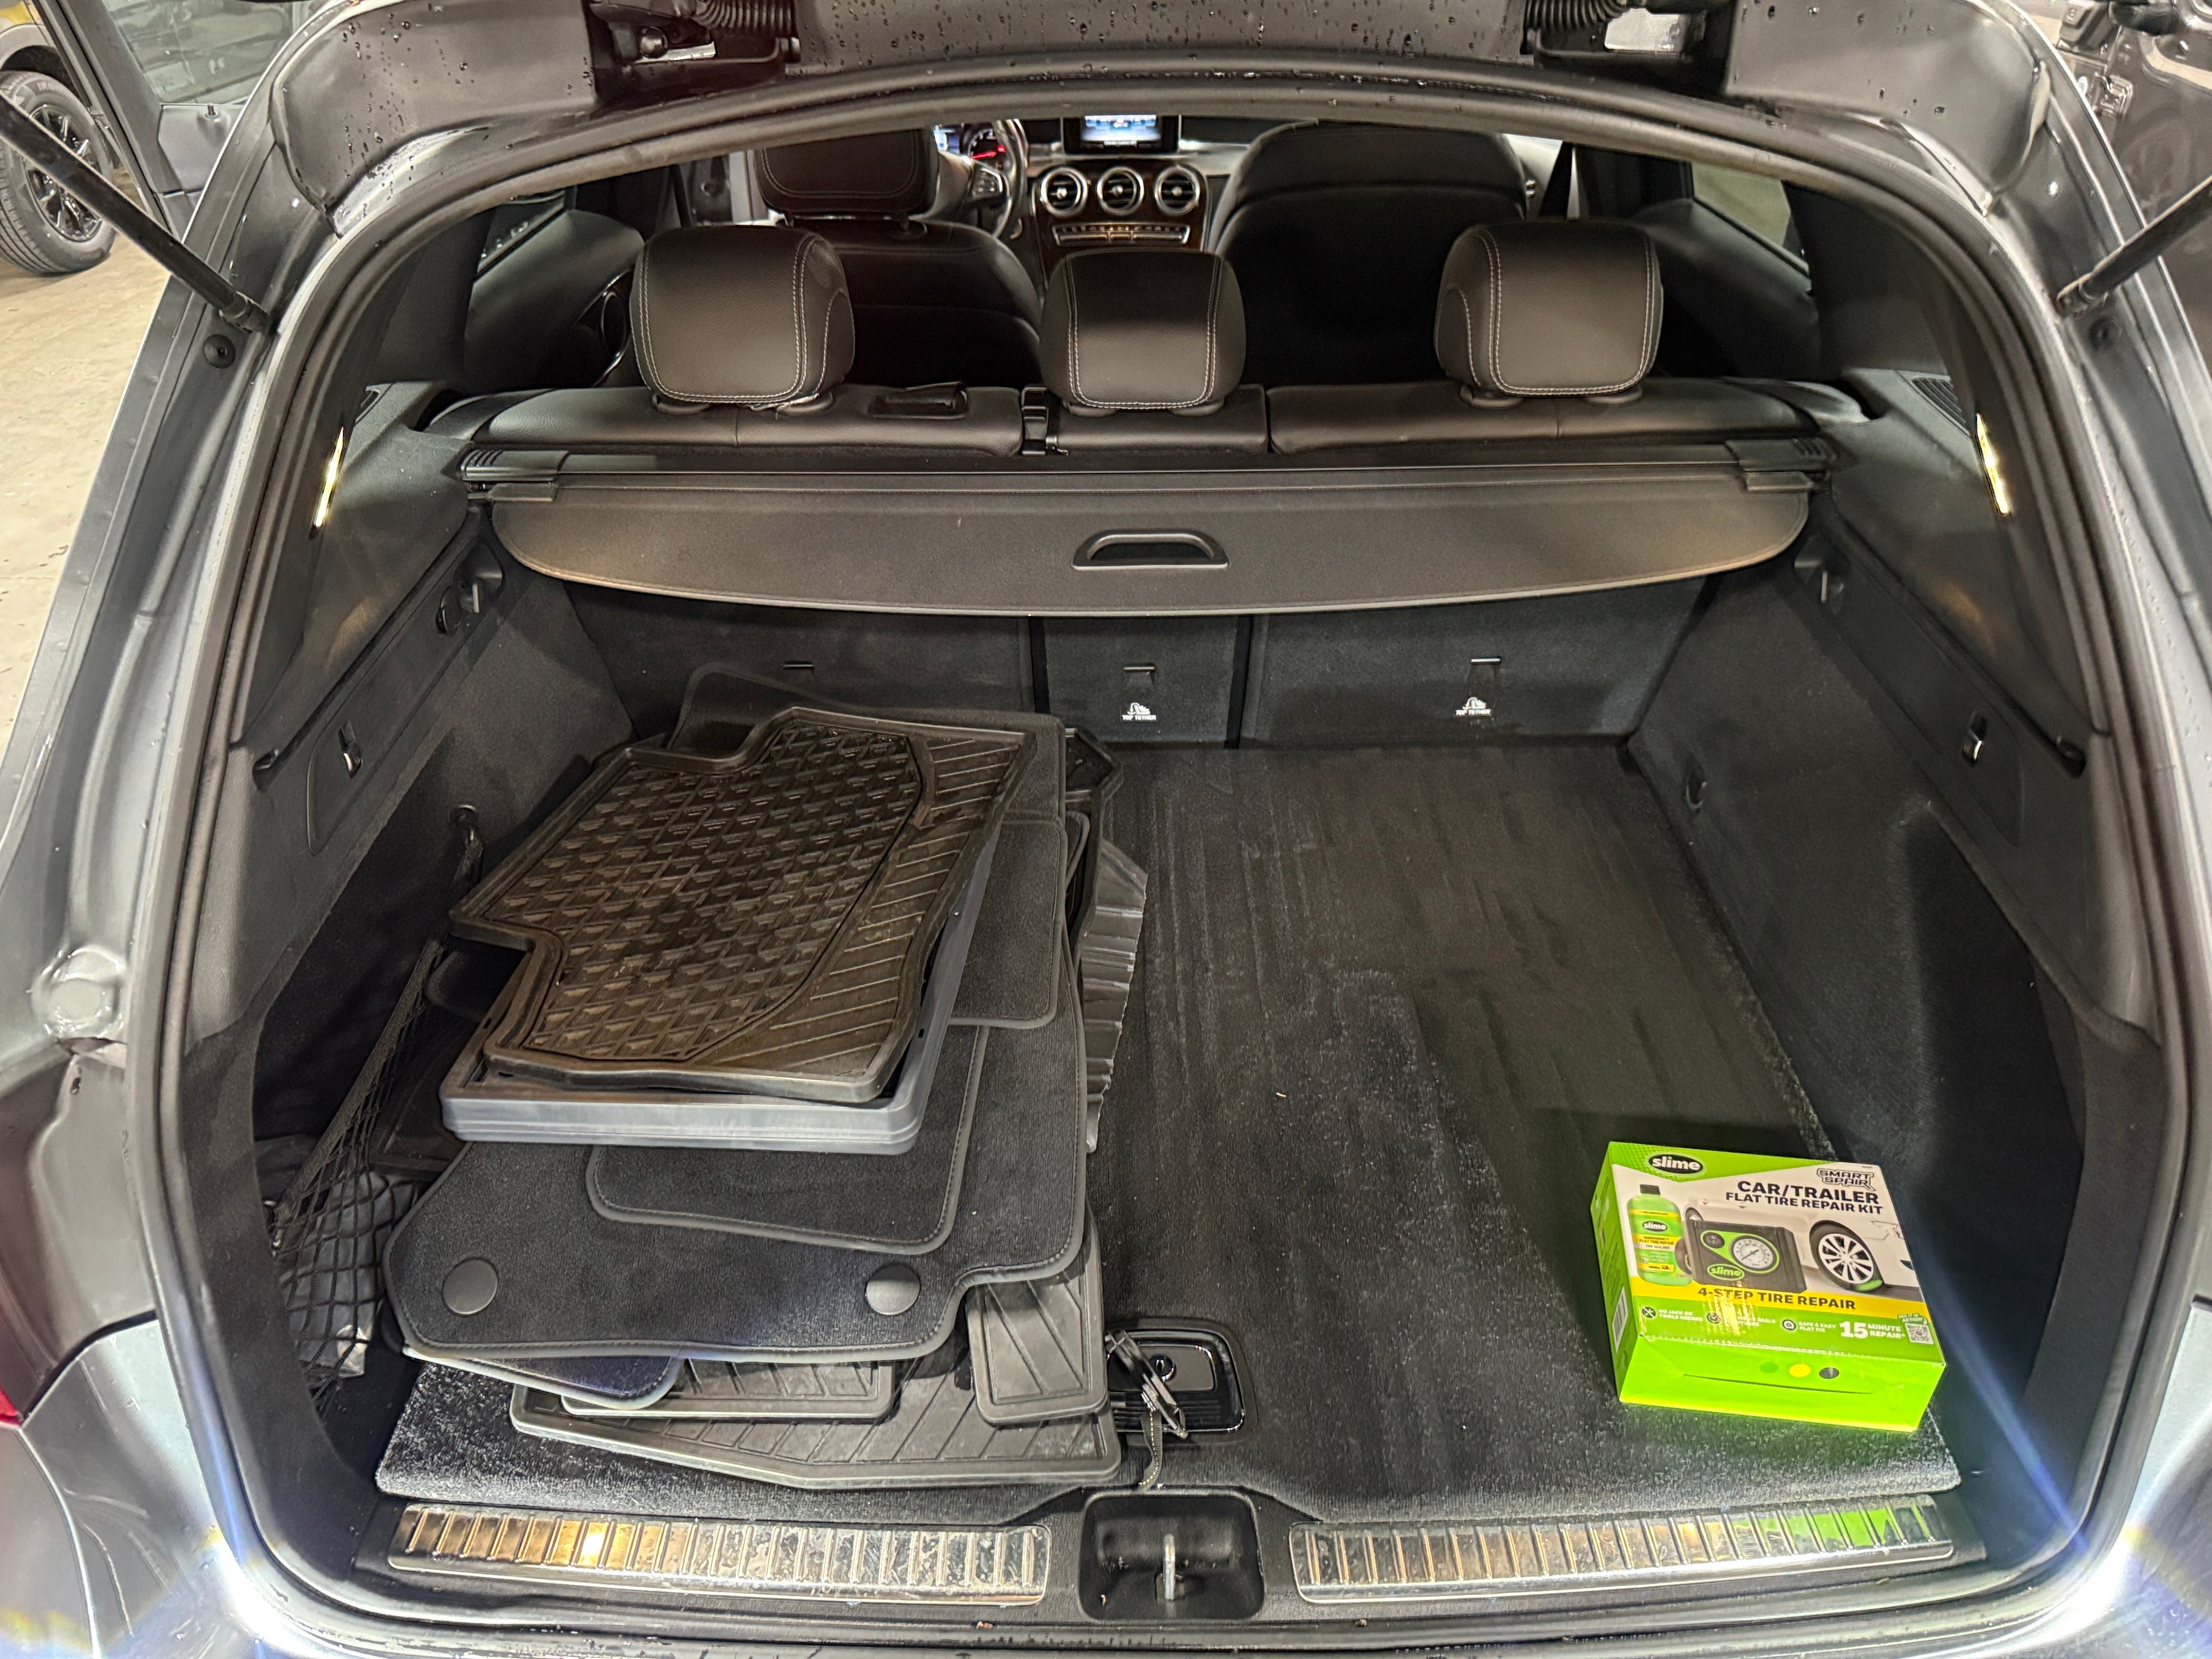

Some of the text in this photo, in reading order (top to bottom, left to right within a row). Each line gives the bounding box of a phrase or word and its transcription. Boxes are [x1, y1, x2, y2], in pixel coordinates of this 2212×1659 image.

[1652, 1156, 1701, 1171] slime
[1819, 1170, 1872, 1180] SMART
[1825, 1177, 1871, 1189] SPAIR
[1737, 1181, 1879, 1204] CAR/TRAILER
[1725, 1192, 1883, 1215] FLAT TIRE REPAIR KIT
[1643, 1222, 1666, 1230] slime
[1711, 1266, 1742, 1277] slime
[1698, 1288, 1856, 1310] 4-STEP TIRE REPAIR
[1839, 1321, 1901, 1339] 15 MINUTE
